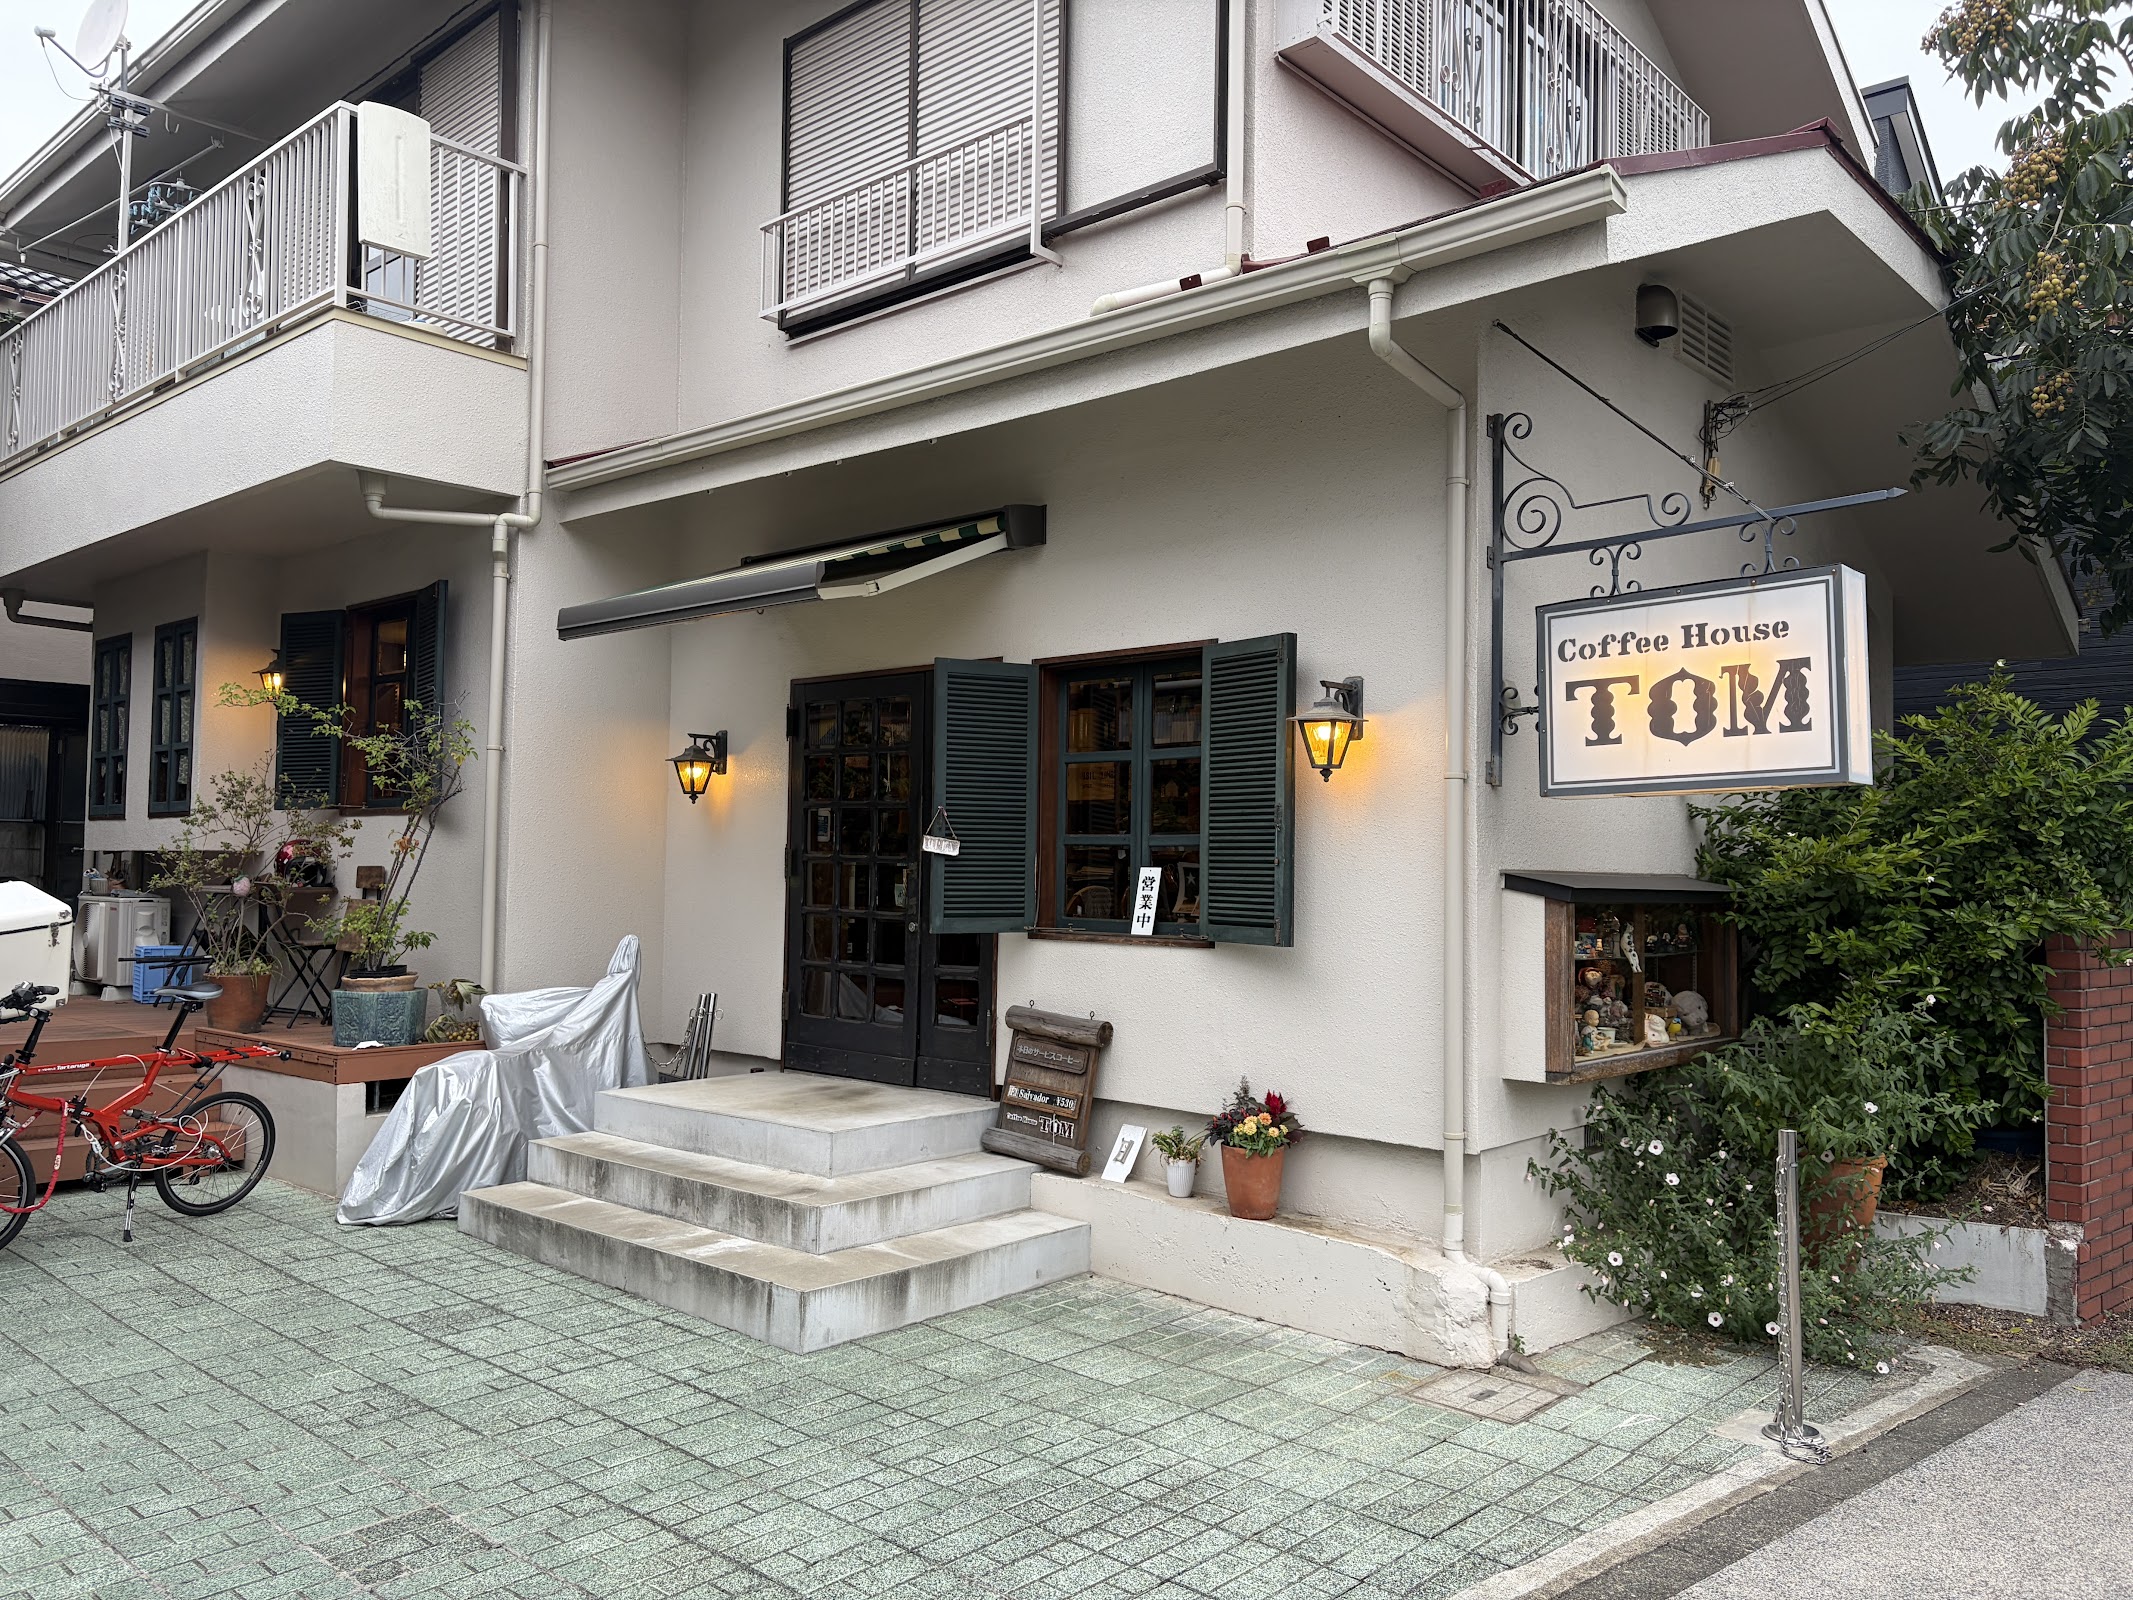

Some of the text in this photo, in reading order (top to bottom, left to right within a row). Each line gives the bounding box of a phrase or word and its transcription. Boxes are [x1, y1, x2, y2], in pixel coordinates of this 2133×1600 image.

[1557, 620, 1790, 663] Coffee House
[1565, 656, 1813, 748] TOM
[1136, 875, 1156, 929] 営業中
[1039, 1115, 1075, 1140] TOM
